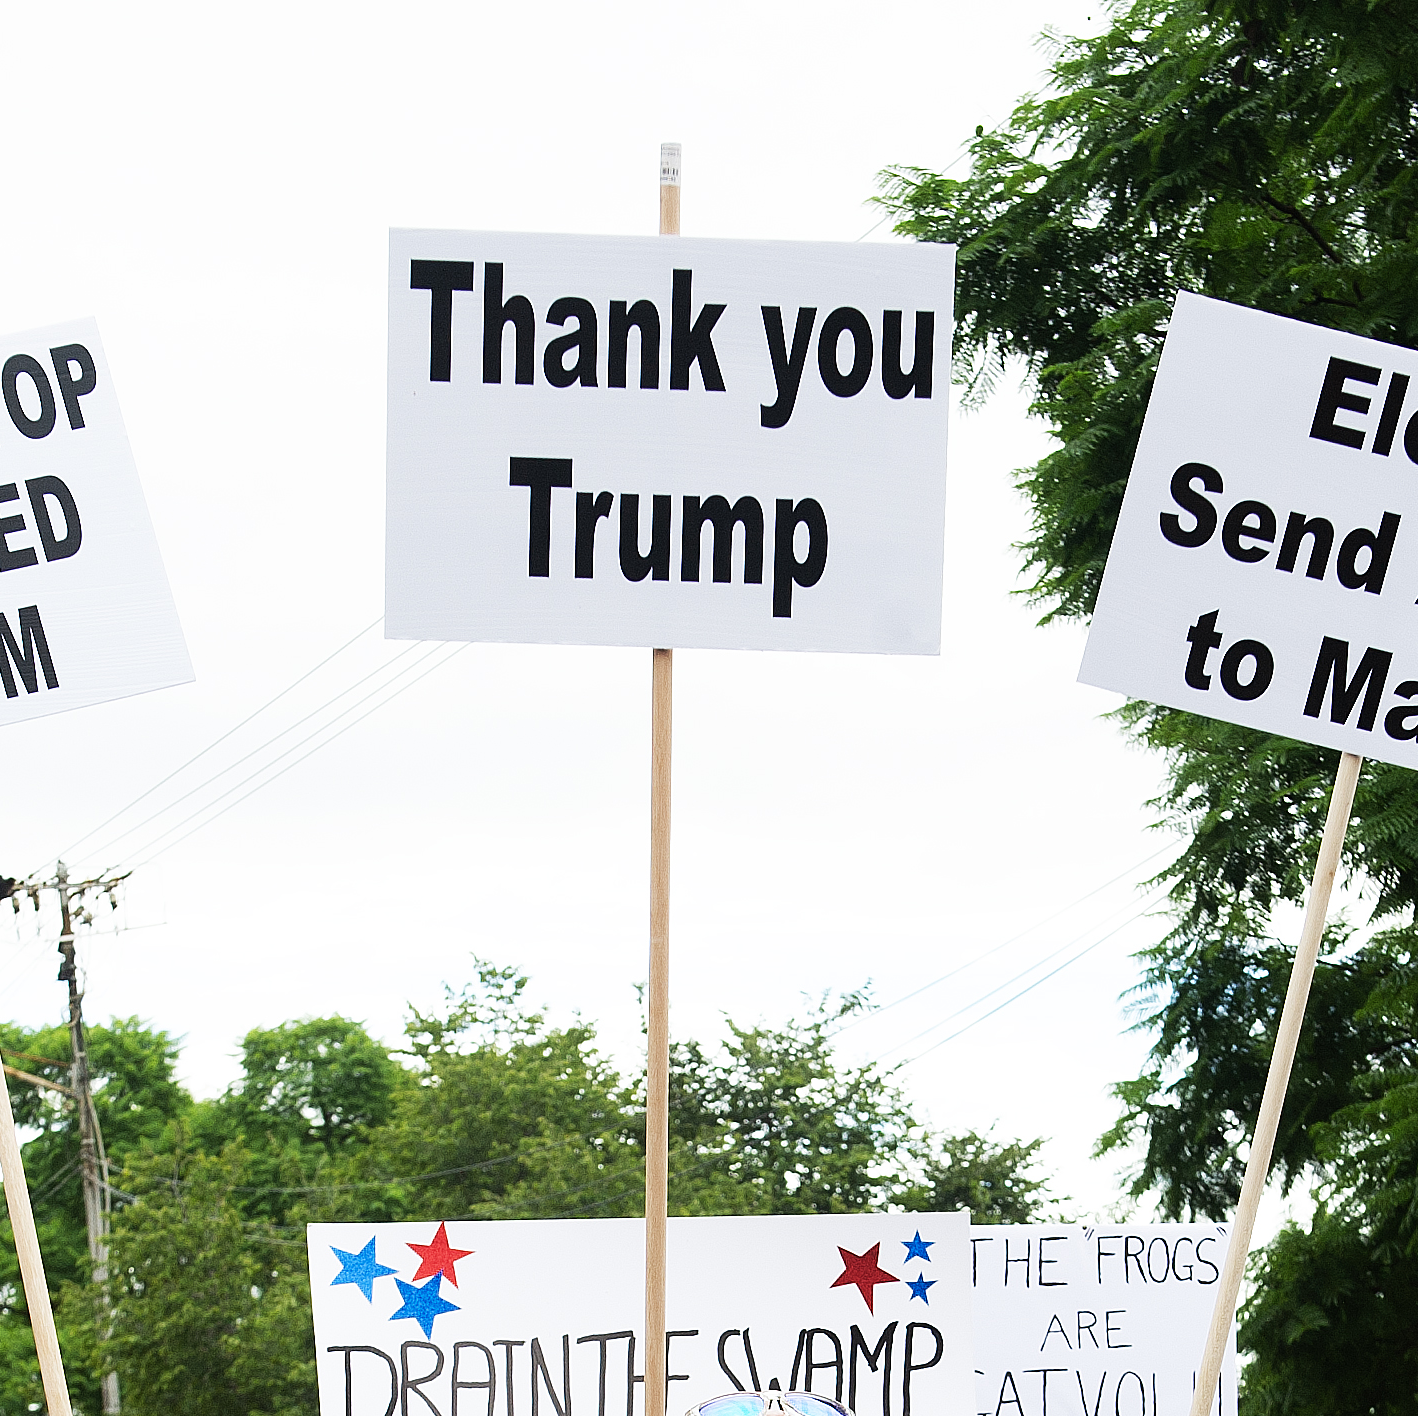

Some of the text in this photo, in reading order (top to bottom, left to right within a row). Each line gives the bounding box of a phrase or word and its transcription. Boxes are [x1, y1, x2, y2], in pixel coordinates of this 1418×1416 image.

[409, 258, 935, 429] Thank you
[508, 456, 829, 619] Trump
[1158, 461, 1402, 596] Send
[1182, 607, 1275, 702] to
[970, 1237, 1069, 1289] THE
[1040, 1309, 1133, 1352] ARE
